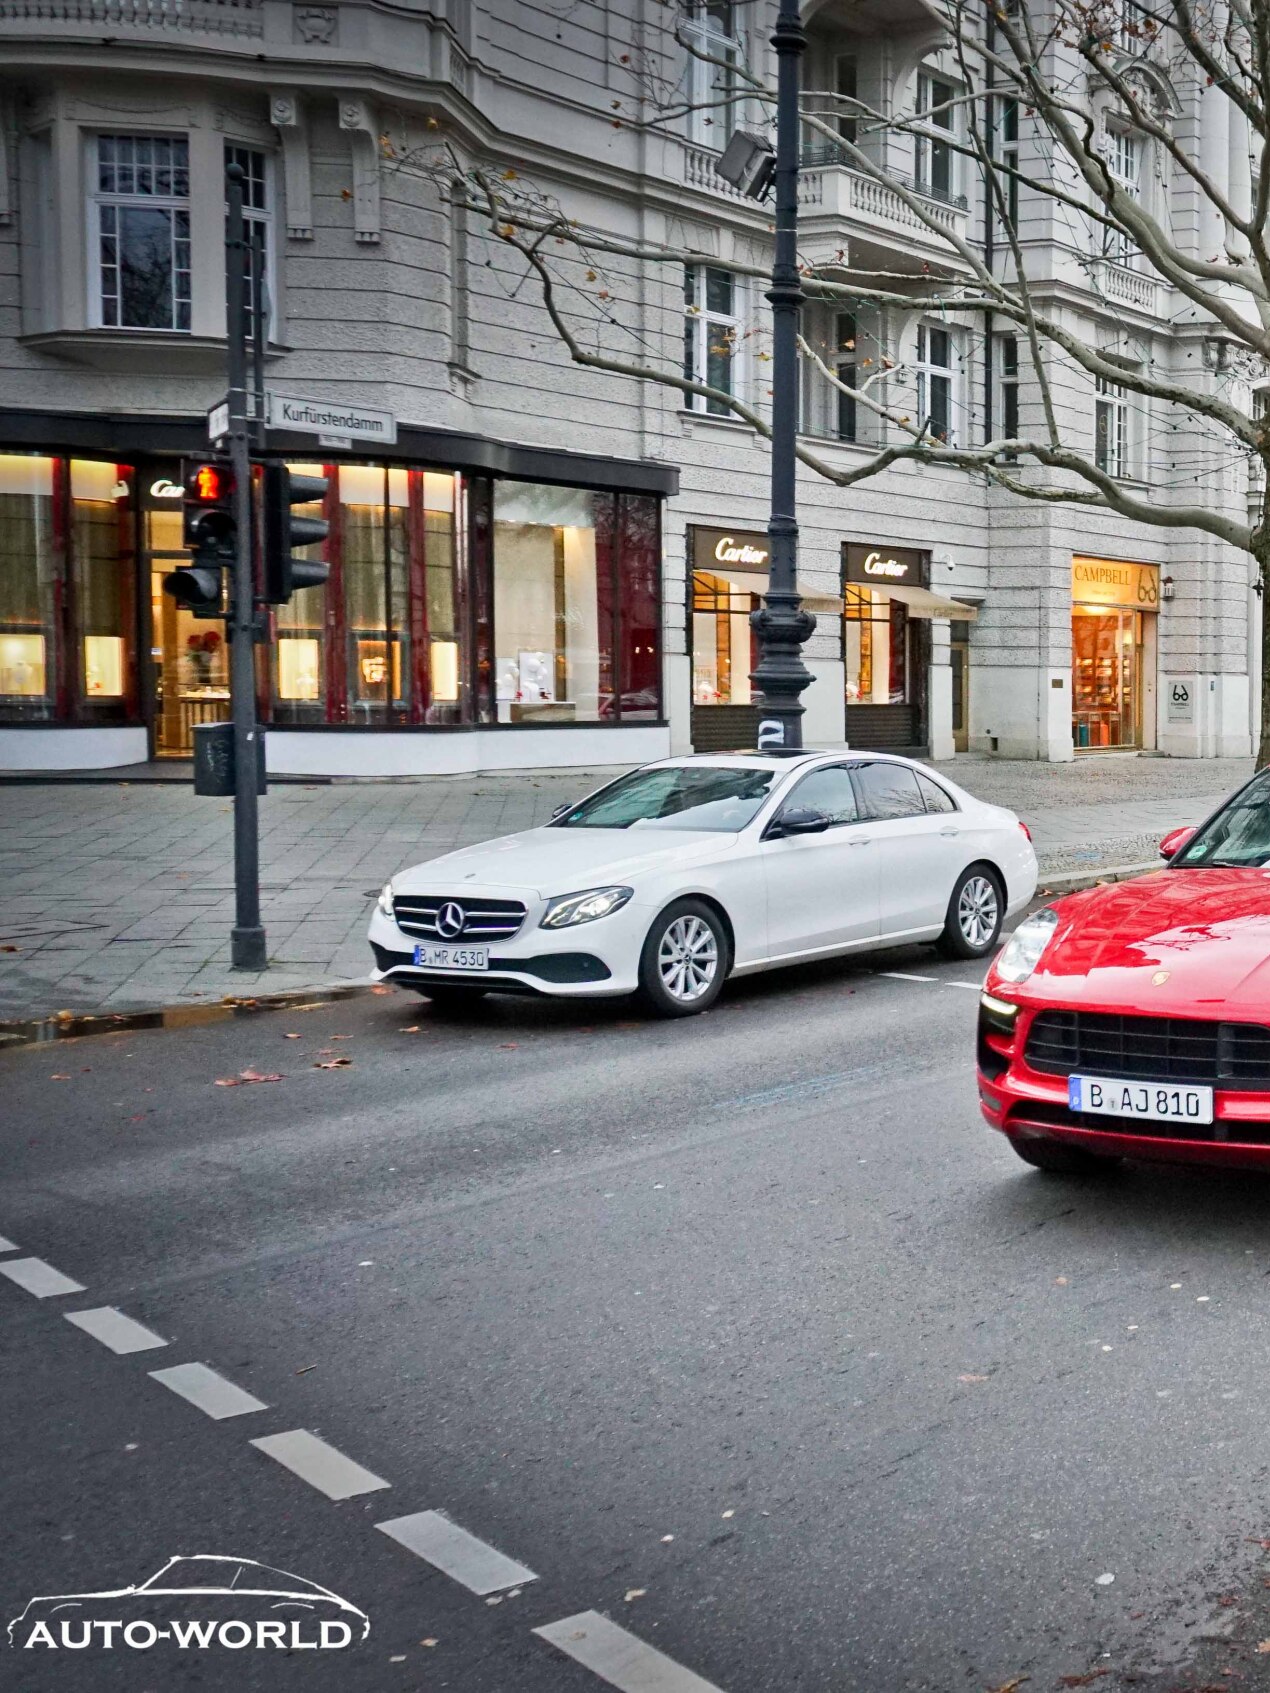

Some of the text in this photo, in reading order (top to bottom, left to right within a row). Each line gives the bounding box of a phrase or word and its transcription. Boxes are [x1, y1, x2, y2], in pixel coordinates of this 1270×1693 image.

[282, 403, 383, 432] Kurfürstendamm
[714, 536, 769, 564] Cartier
[864, 552, 909, 577] Cartier
[1074, 565, 1131, 586] CAMPBELL
[420, 948, 426, 963] B
[453, 951, 484, 967] 4530
[1090, 1084, 1200, 1117] B AJ 810
